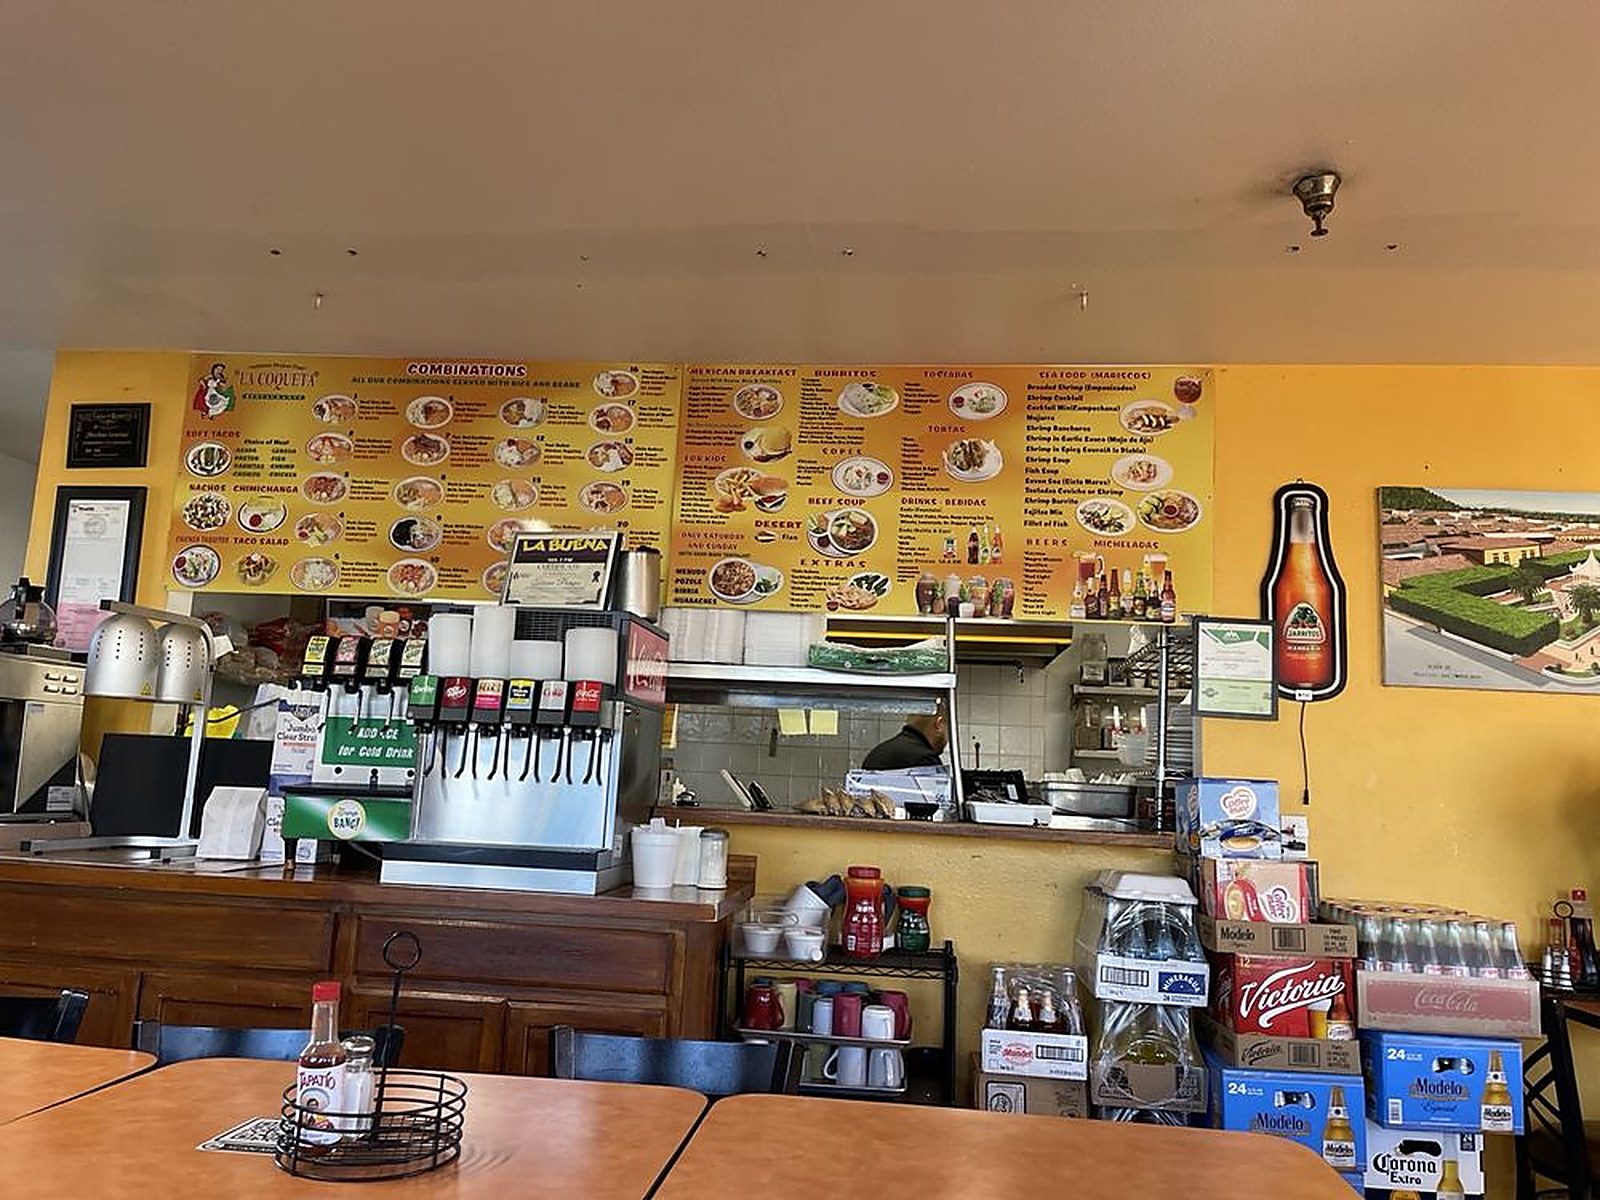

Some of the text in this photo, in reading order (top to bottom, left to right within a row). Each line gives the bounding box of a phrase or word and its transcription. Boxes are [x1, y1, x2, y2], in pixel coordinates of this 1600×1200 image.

[407, 362, 525, 377] COMBINATIONS
[814, 369, 876, 378] BURRITOS
[1025, 467, 1040, 475] Fish
[189, 483, 299, 494] NACHOS CHIMICHANGA
[836, 498, 867, 506] SOUP
[901, 497, 987, 507] DRINKS BEBIDAS
[754, 520, 803, 529] DESERT
[1053, 519, 1069, 527] Fish
[233, 538, 290, 547] TACO SALAD
[782, 532, 799, 541] Flan
[523, 540, 609, 552] LA BUENA
[1026, 538, 1160, 550] BEERS MICHELADAS
[799, 558, 868, 569] EXTRAS
[1287, 628, 1320, 638] JARRITOS
[277, 731, 298, 742] Clear
[357, 727, 377, 739] ADD
[338, 745, 414, 759] for Cold Drink
[1220, 926, 1256, 942] Modelo
[1162, 973, 1202, 993] MINERAGUA
[1240, 960, 1346, 1028] Victoria
[1387, 1048, 1406, 1060] 24
[1227, 1083, 1247, 1095] 24
[1416, 1077, 1463, 1096] Modelo
[1255, 1112, 1304, 1130] Modelo
[1373, 1152, 1437, 1176] Corona
[1390, 1172, 1422, 1185] Extra
